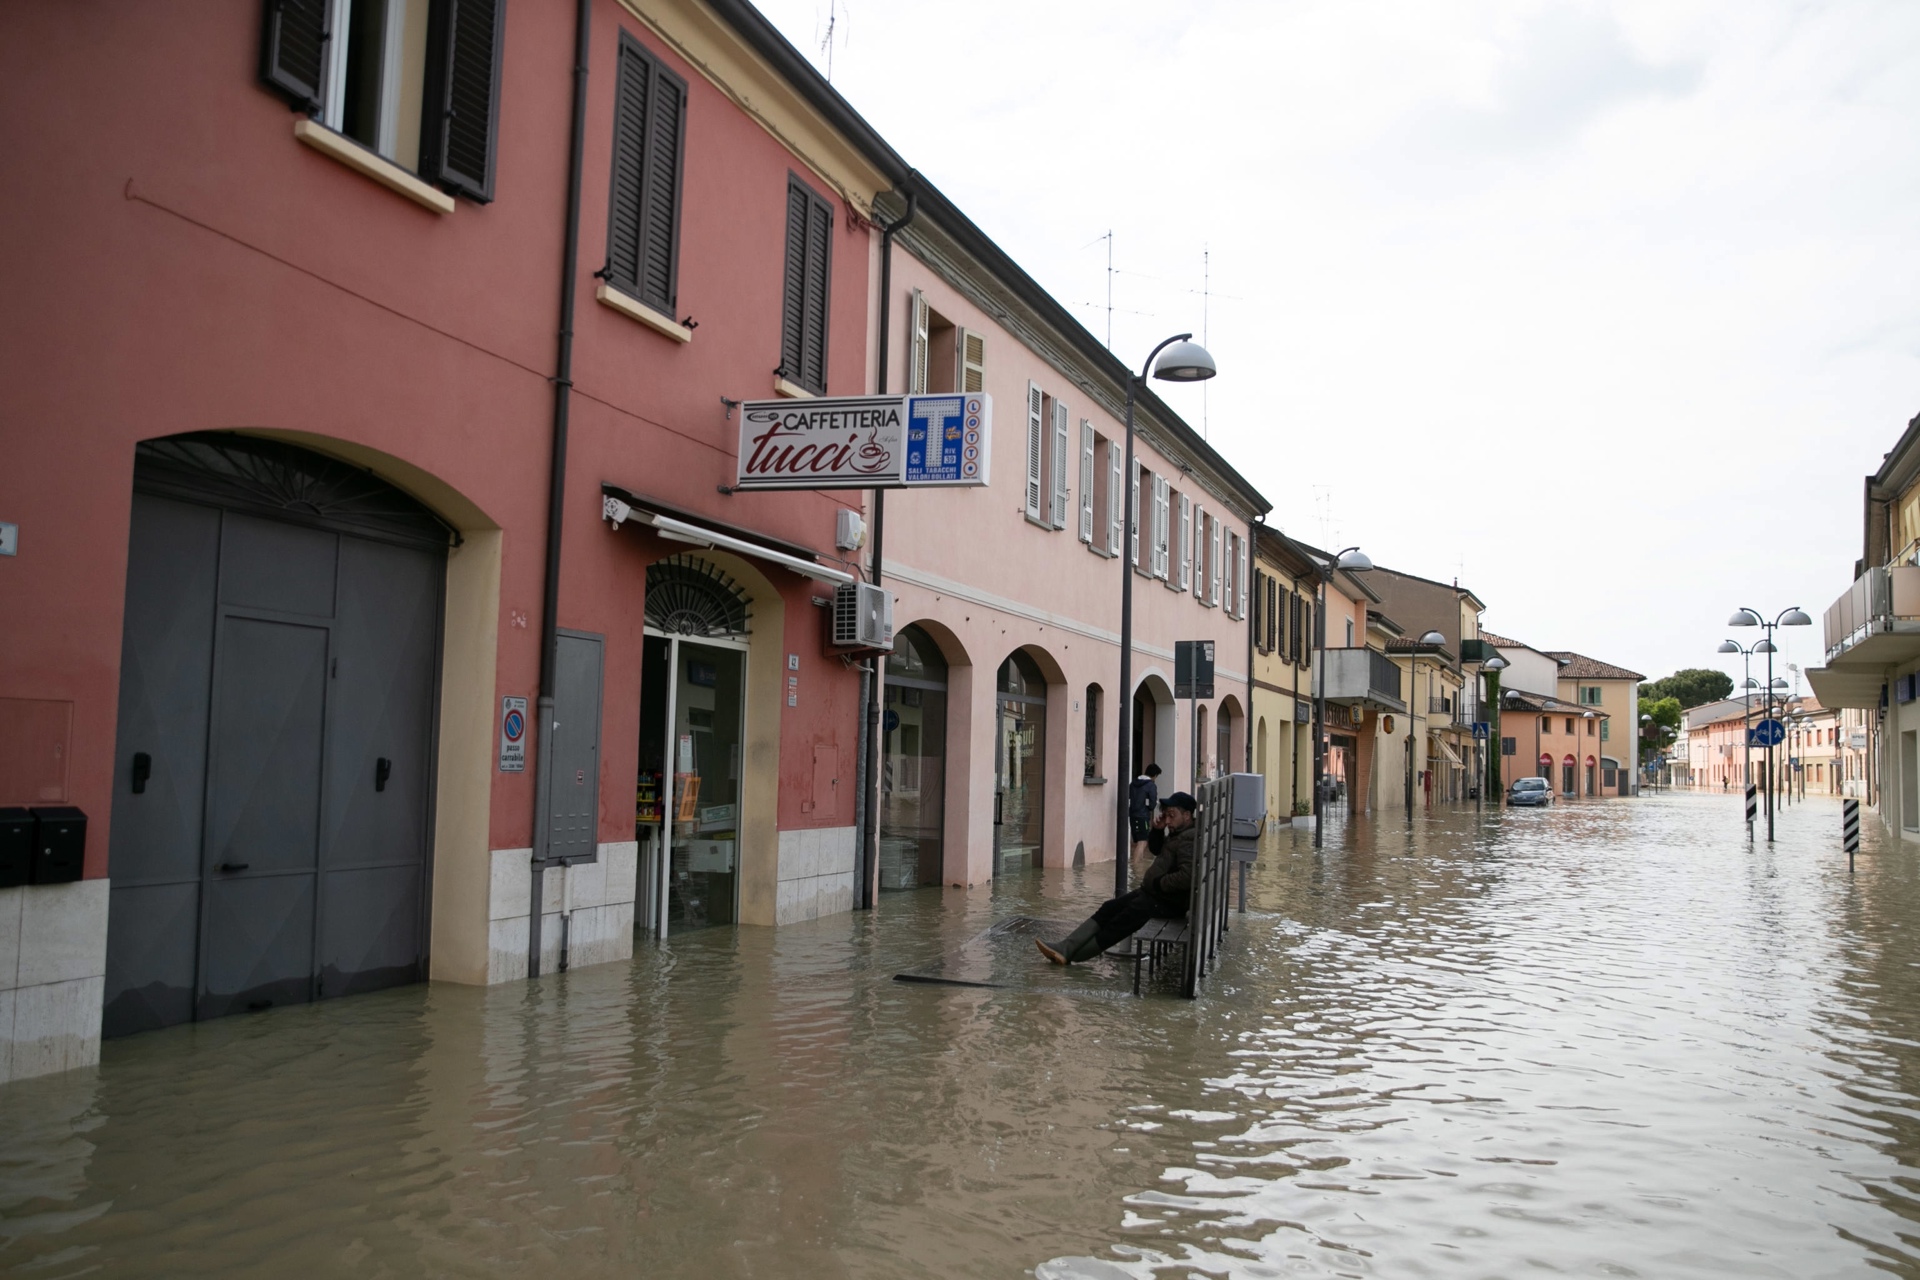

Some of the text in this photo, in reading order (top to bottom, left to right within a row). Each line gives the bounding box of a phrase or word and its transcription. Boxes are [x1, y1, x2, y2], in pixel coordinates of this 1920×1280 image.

[783, 408, 900, 430] CAFFETTERIA
[506, 745, 520, 753] passo
[501, 753, 524, 762] carrabile
